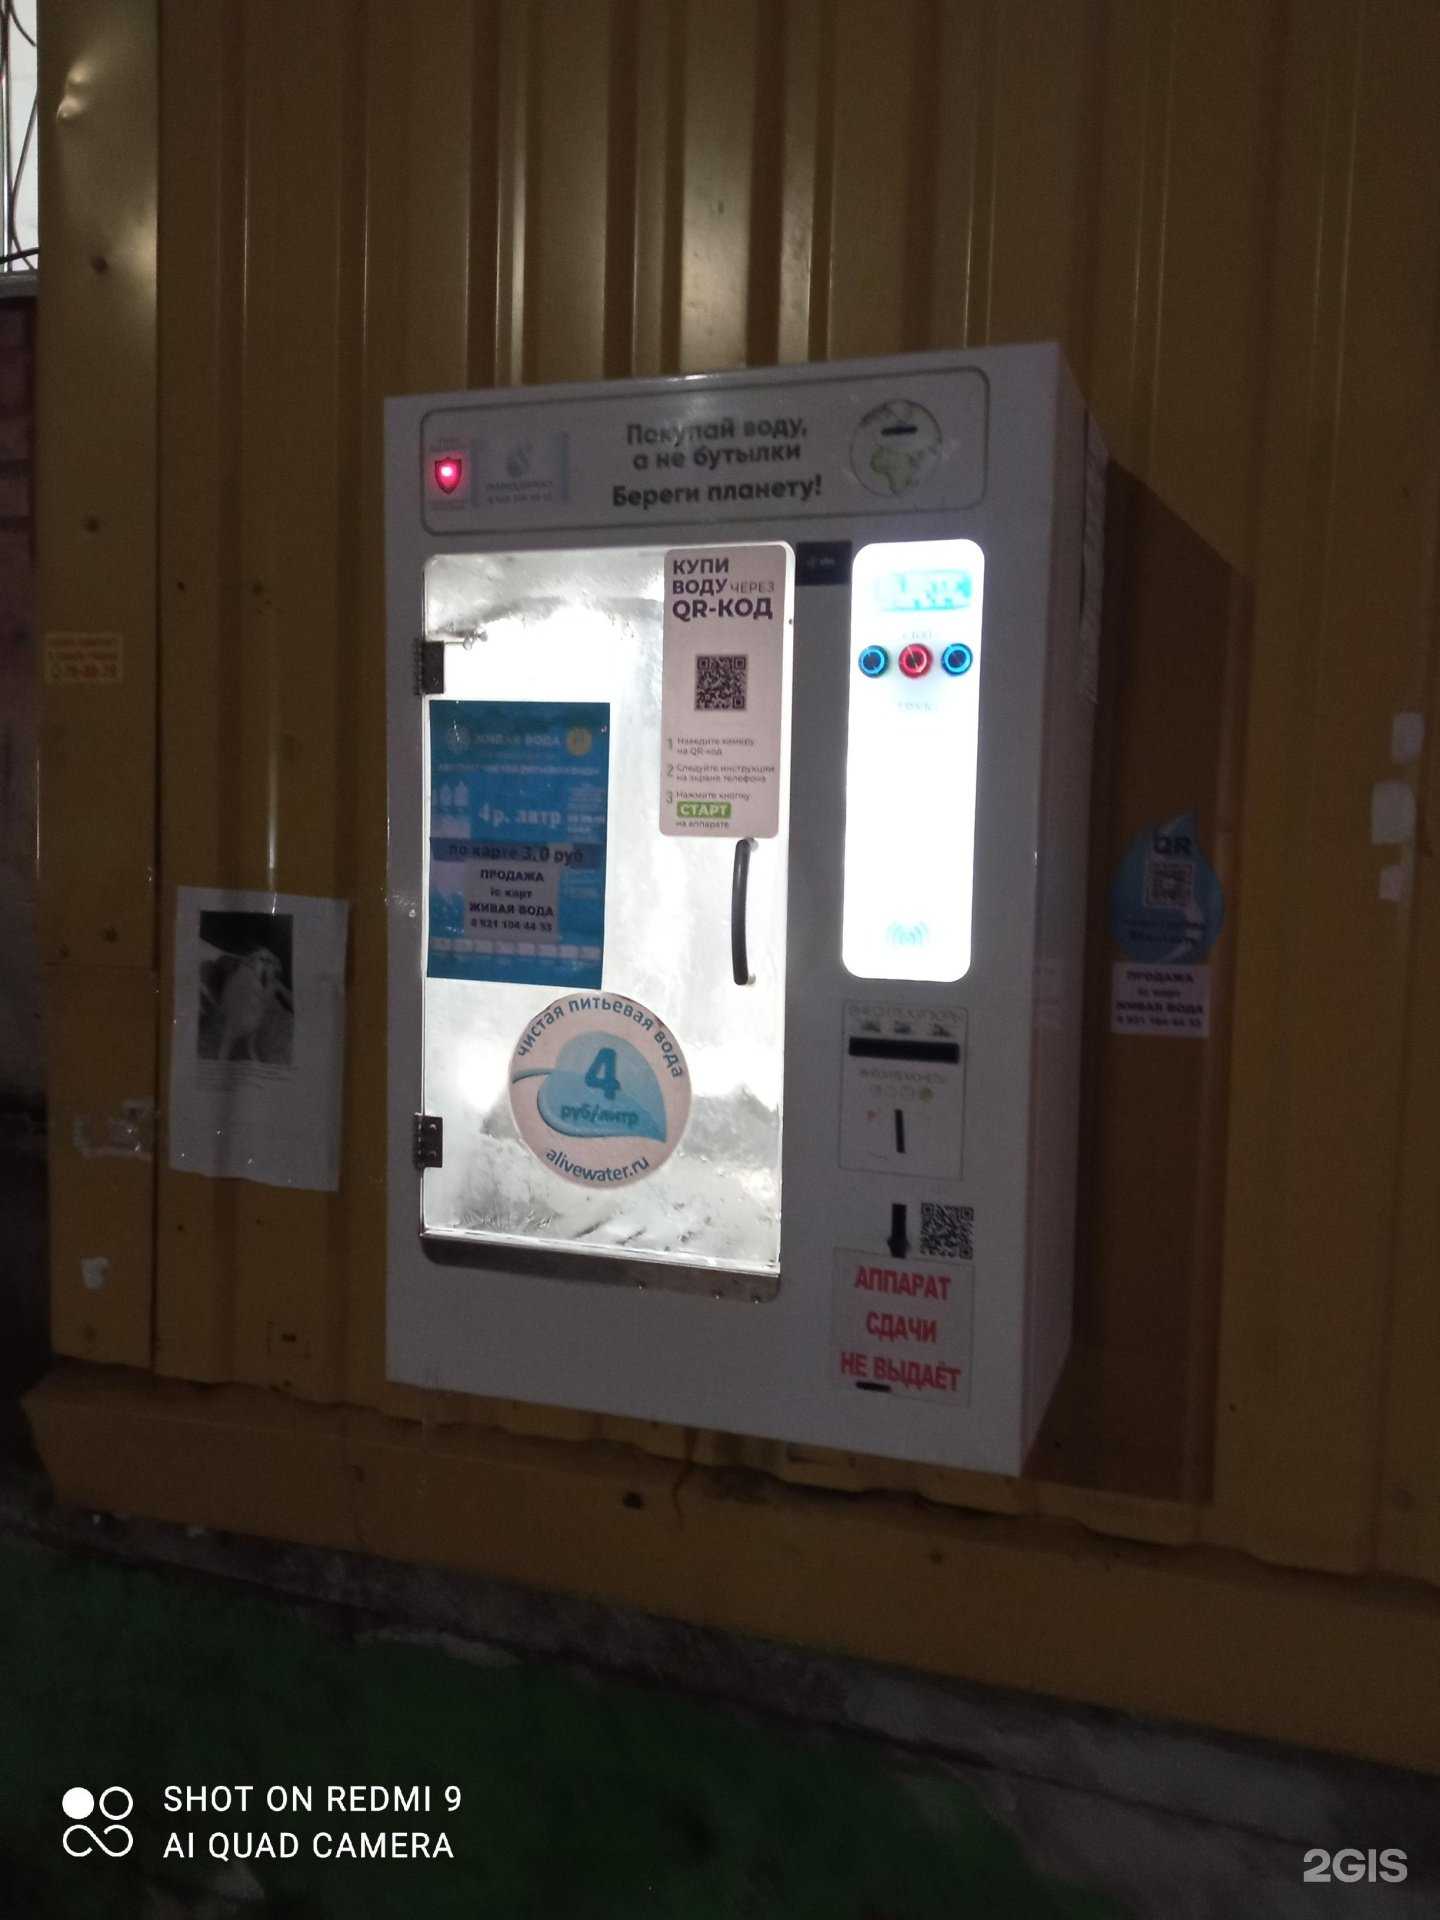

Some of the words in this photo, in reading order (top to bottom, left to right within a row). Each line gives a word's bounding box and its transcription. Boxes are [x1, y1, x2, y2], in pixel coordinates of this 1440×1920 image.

[626, 417, 736, 447] Покупай
[743, 417, 808, 440] воду,
[633, 453, 649, 471] а
[656, 450, 685, 469] не
[693, 443, 801, 471] бутылки
[612, 485, 700, 510] Береги
[707, 473, 822, 502] планету!
[673, 557, 729, 575] КУПИ
[673, 578, 728, 597] ВОДУ
[730, 580, 775, 594] ЧЕРЕЗ
[672, 597, 774, 623] QR-КОД
[524, 732, 561, 747] ВОДА
[677, 737, 720, 746] Наведите
[722, 737, 755, 747] камеру
[689, 747, 722, 756] QR-код
[676, 763, 719, 773] Следуйте
[720, 764, 776, 774] инструкции
[723, 775, 767, 784] телефона
[676, 791, 717, 799] Нажмите
[719, 792, 752, 802] кнопку
[680, 804, 728, 816] СТАРТ
[688, 820, 729, 829] аппарате
[448, 844, 466, 856] по
[471, 845, 519, 860] карте
[554, 848, 585, 866] руб
[1154, 836, 1192, 856] QR
[480, 869, 544, 882] ПРОДАЖА
[504, 888, 533, 900] карт
[469, 901, 514, 914] ЖИВАЯ
[519, 903, 554, 917] ВОДА
[1126, 971, 1194, 983] ПРОДАЖА
[1167, 1003, 1203, 1015] ВОДА
[518, 1005, 564, 1057] чистая
[569, 997, 653, 1031] питьевая
[654, 1031, 683, 1078] вода
[584, 1047, 620, 1100] 4
[561, 1104, 640, 1126] руб/литр
[546, 1149, 650, 1182] alivewater.ru
[854, 1265, 952, 1300] АППАРАТ
[866, 1311, 937, 1343] СДАЧИ
[840, 1351, 868, 1378] НЕ
